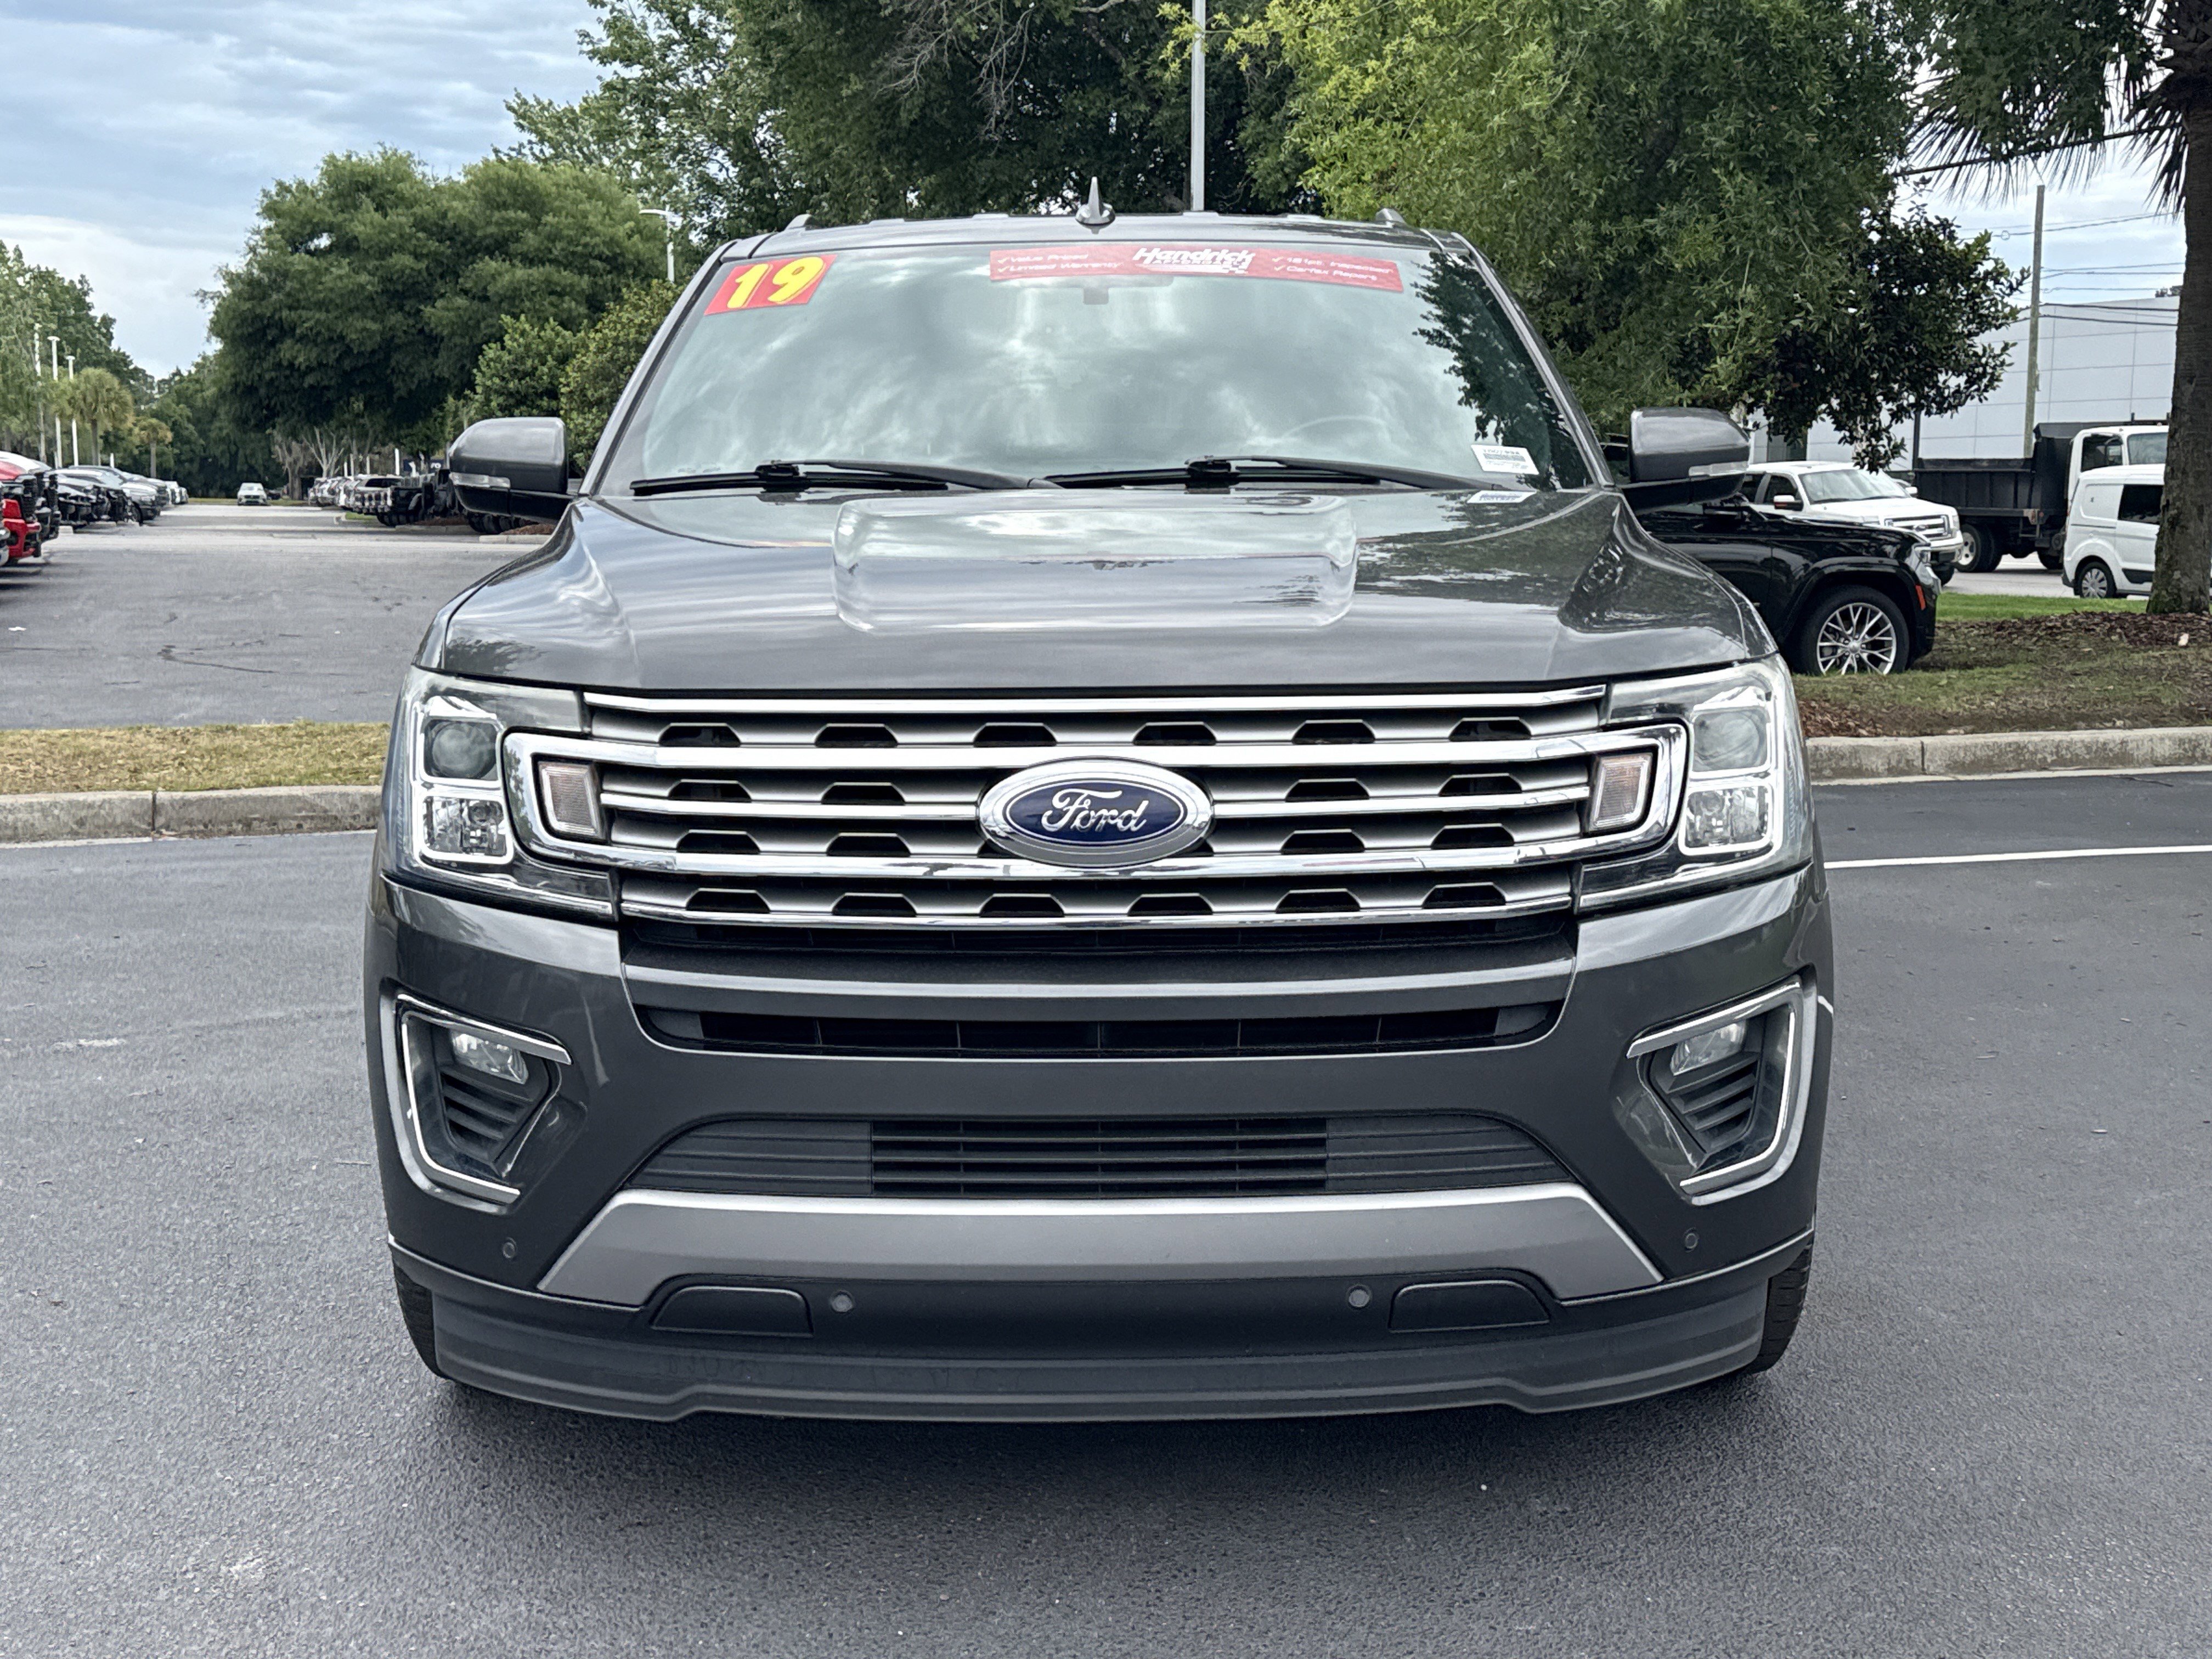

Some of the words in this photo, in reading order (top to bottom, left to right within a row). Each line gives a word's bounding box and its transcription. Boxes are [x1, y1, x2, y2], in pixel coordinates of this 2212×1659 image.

[1132, 247, 1256, 268] Hendrick
[727, 256, 826, 309] 19
[1041, 788, 1150, 833] Ford
